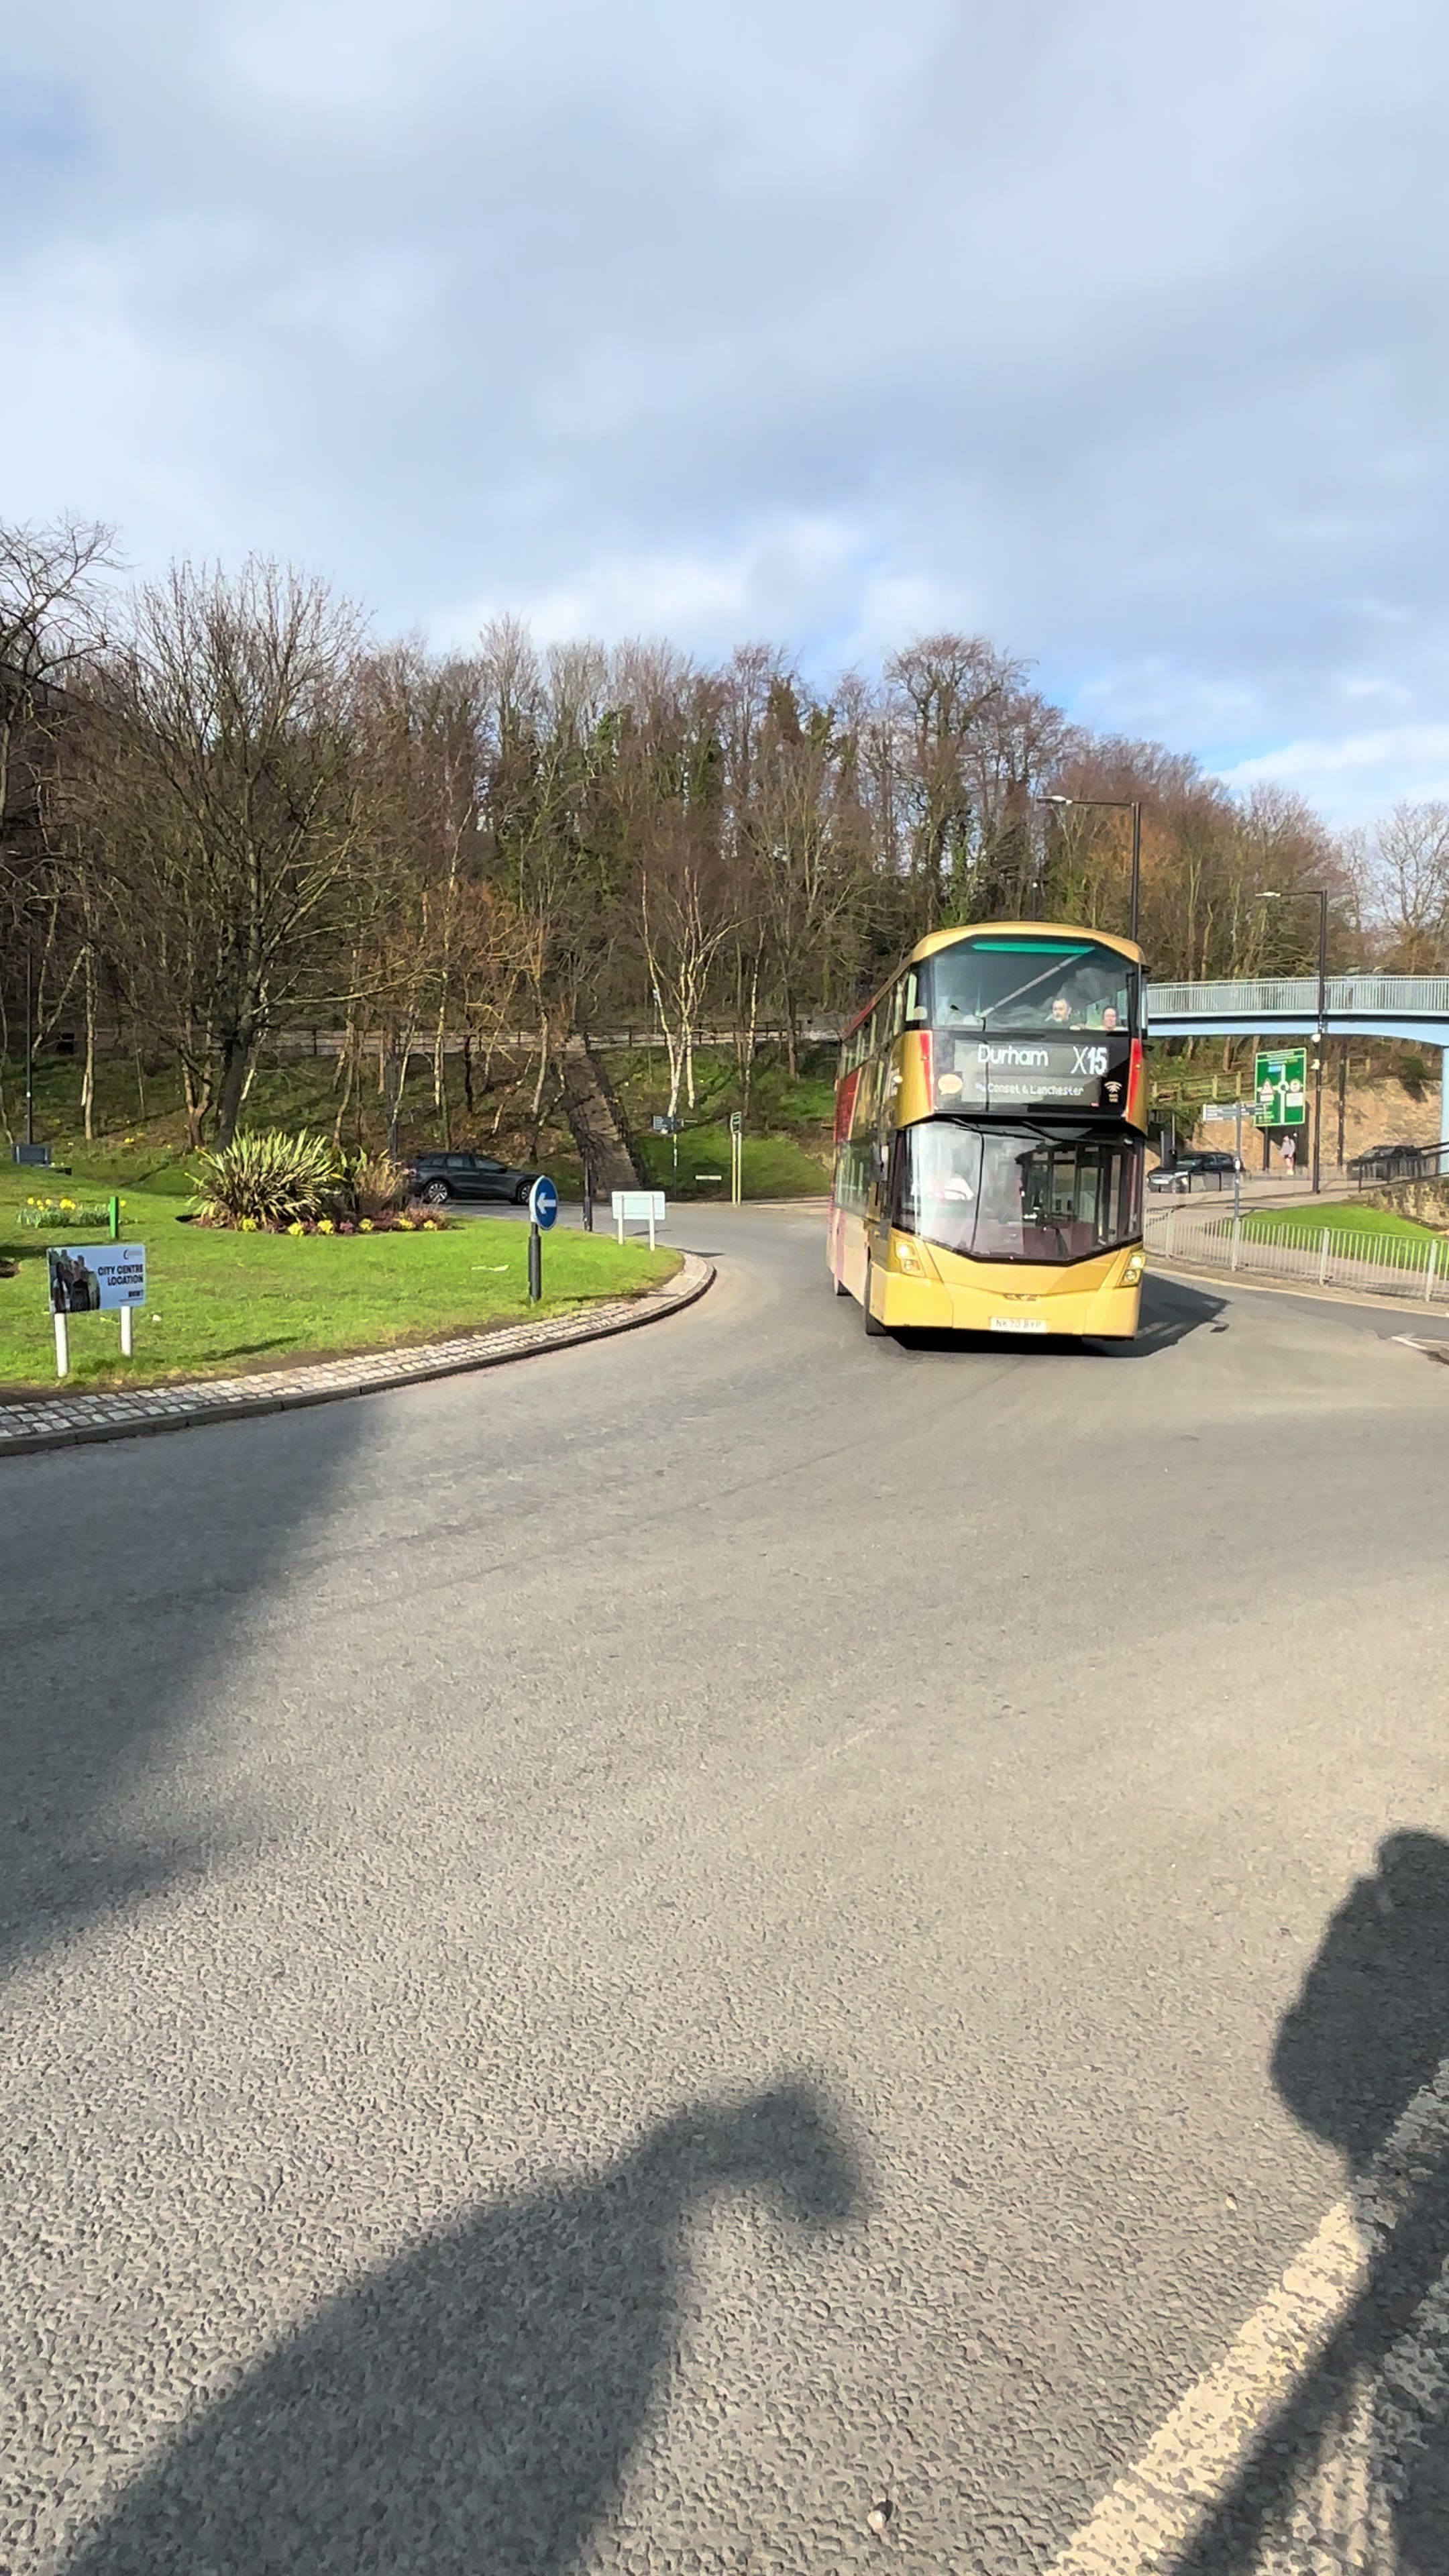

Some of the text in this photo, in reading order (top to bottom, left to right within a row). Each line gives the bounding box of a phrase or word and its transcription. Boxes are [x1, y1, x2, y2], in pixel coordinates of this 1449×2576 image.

[977, 1044, 1108, 1075] Durham X15
[1030, 1084, 1084, 1096] Lanchester
[97, 1264, 144, 1276] CITY CENTRE
[107, 1275, 144, 1286] LOCATION
